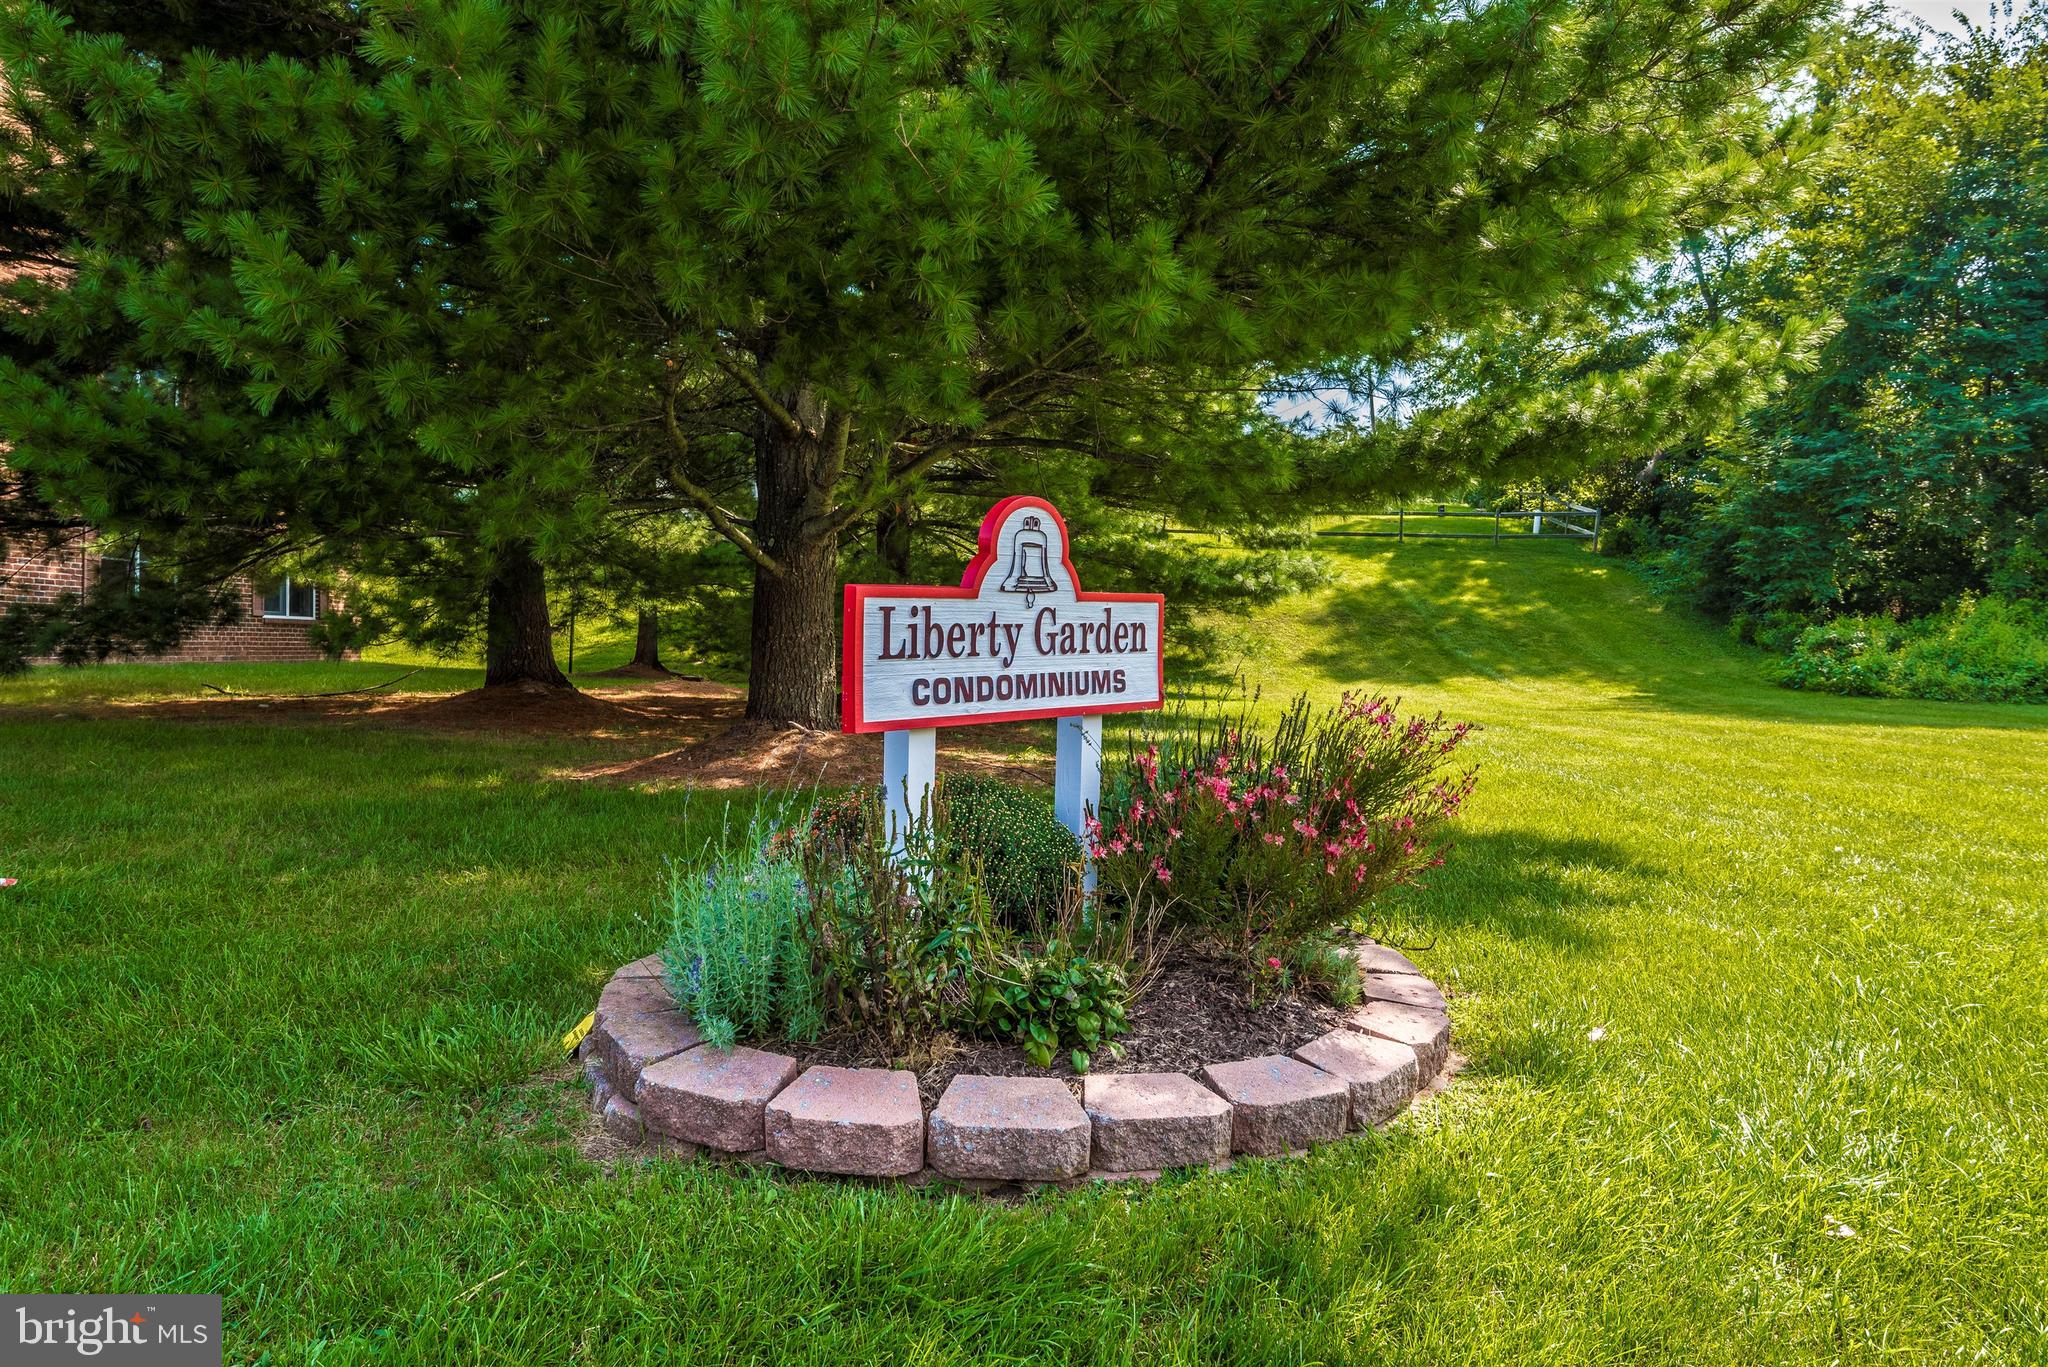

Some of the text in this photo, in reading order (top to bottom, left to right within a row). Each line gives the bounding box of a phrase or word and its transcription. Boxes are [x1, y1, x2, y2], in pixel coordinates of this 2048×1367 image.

[878, 606, 1148, 668] Liberty Garden
[912, 669, 1126, 706] CONDOMINIUMS
